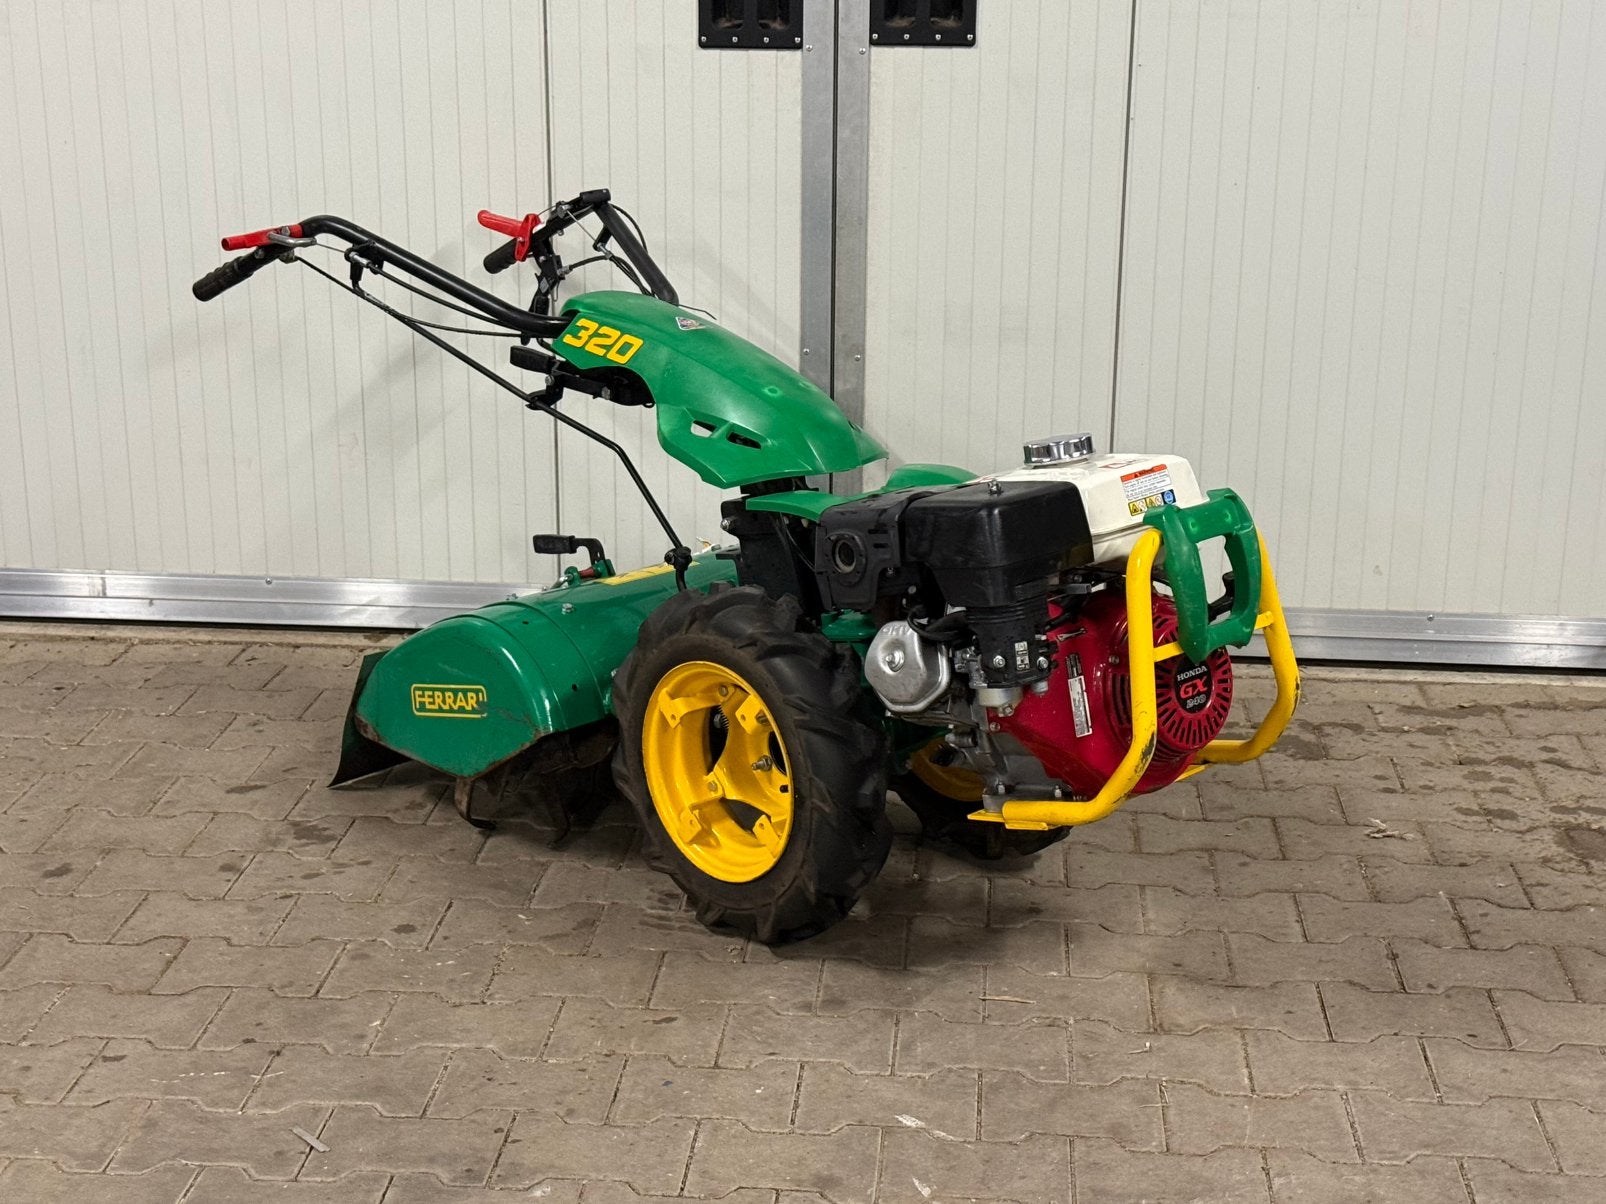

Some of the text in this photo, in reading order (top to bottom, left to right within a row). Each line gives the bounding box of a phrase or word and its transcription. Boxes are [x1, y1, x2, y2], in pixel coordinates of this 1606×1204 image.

[563, 318, 644, 364] 320
[1177, 665, 1207, 681] HONDA
[1180, 676, 1207, 699] GX
